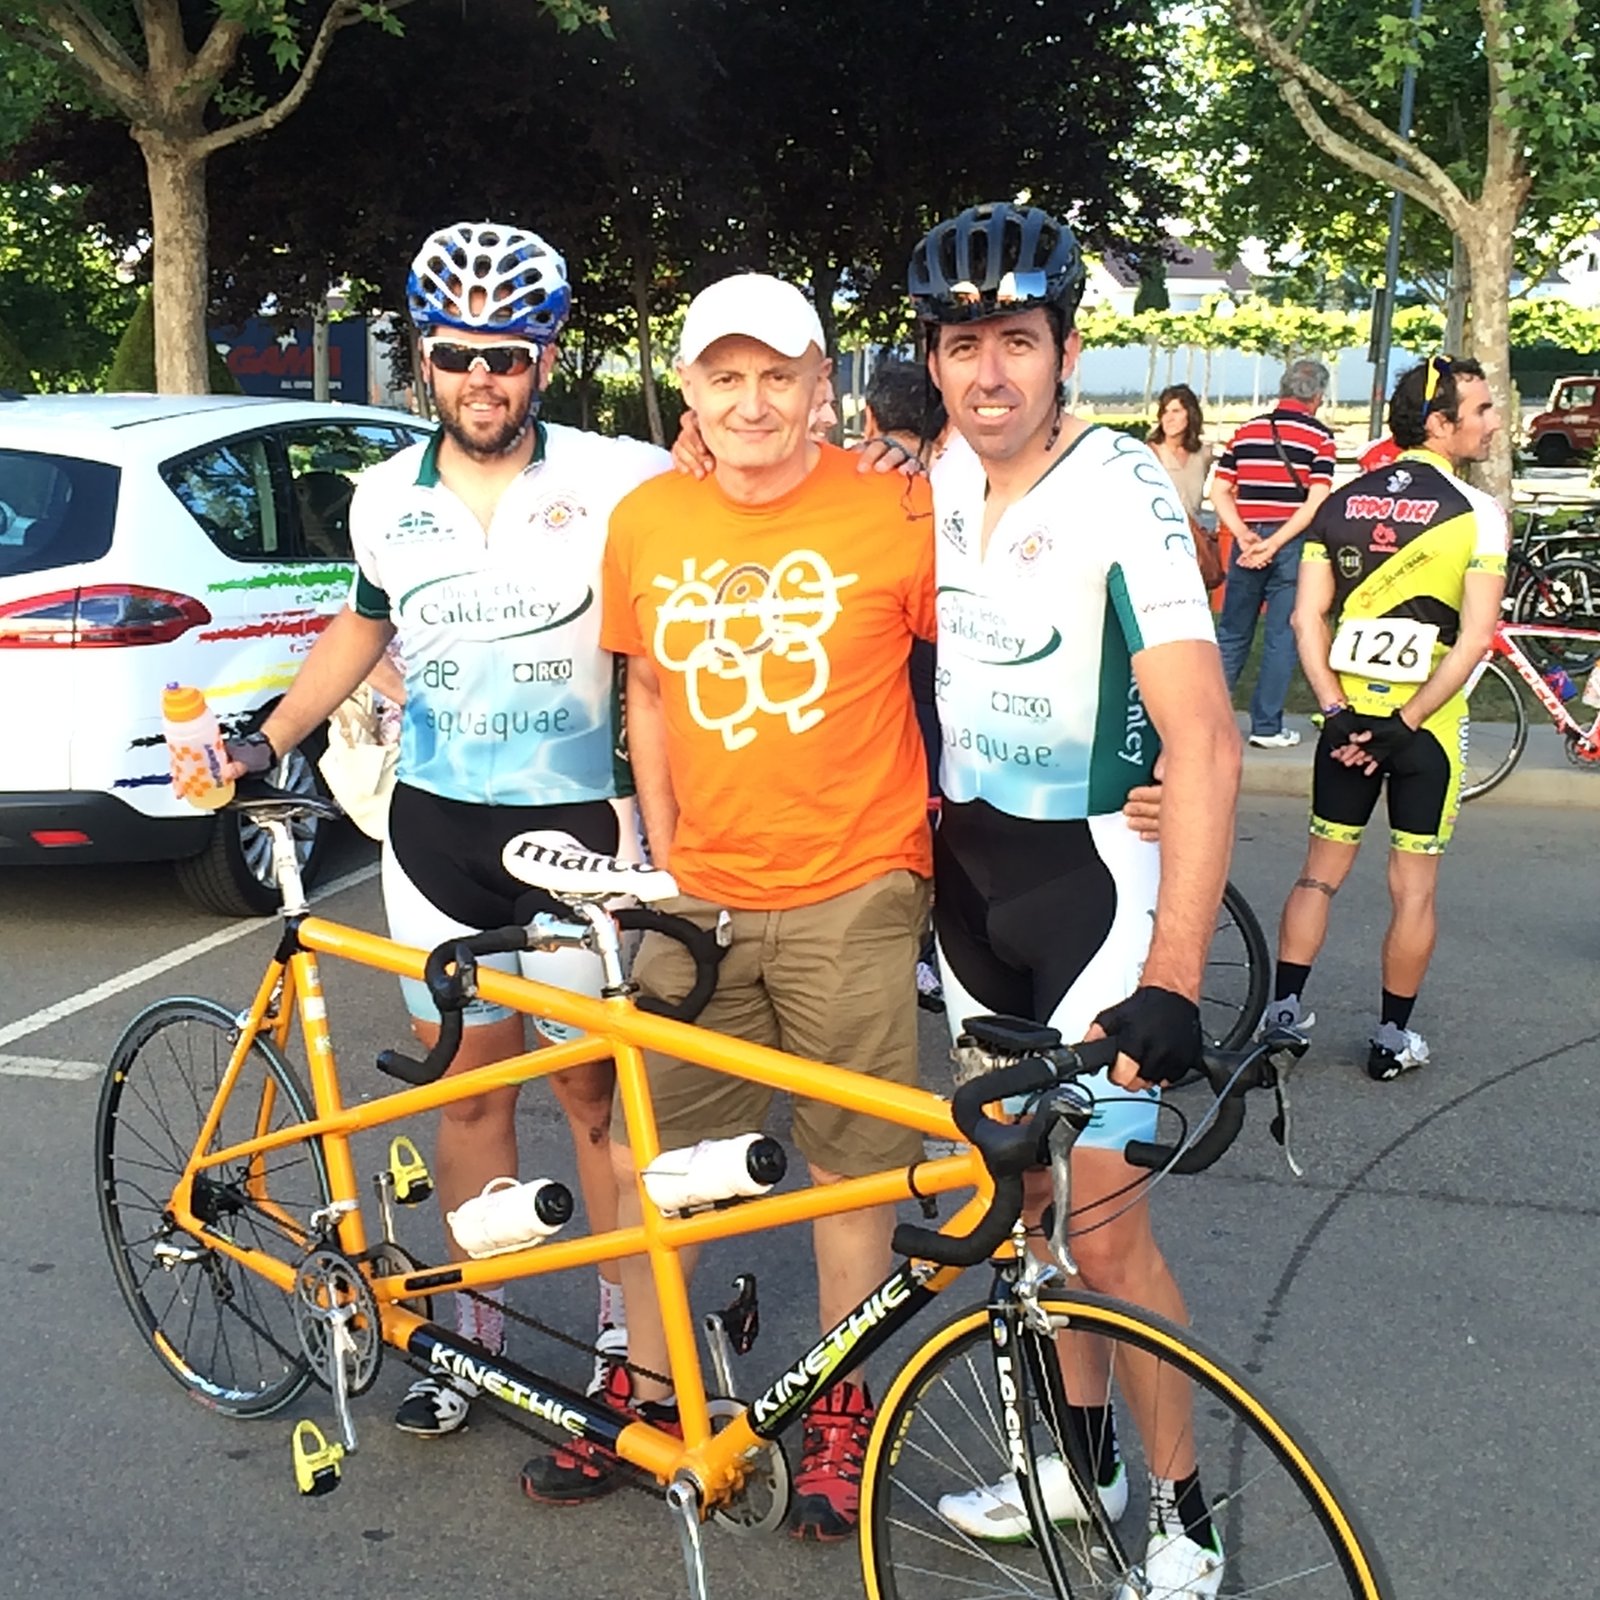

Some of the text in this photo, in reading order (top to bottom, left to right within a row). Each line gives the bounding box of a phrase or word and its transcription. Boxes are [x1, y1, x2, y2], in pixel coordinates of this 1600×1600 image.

[1345, 495, 1440, 526] TODO BICI
[420, 599, 561, 626] Caldentey
[1350, 630, 1418, 669] 126
[754, 1273, 911, 1423] KINETHIC
[430, 1342, 588, 1437] KINETHIC
